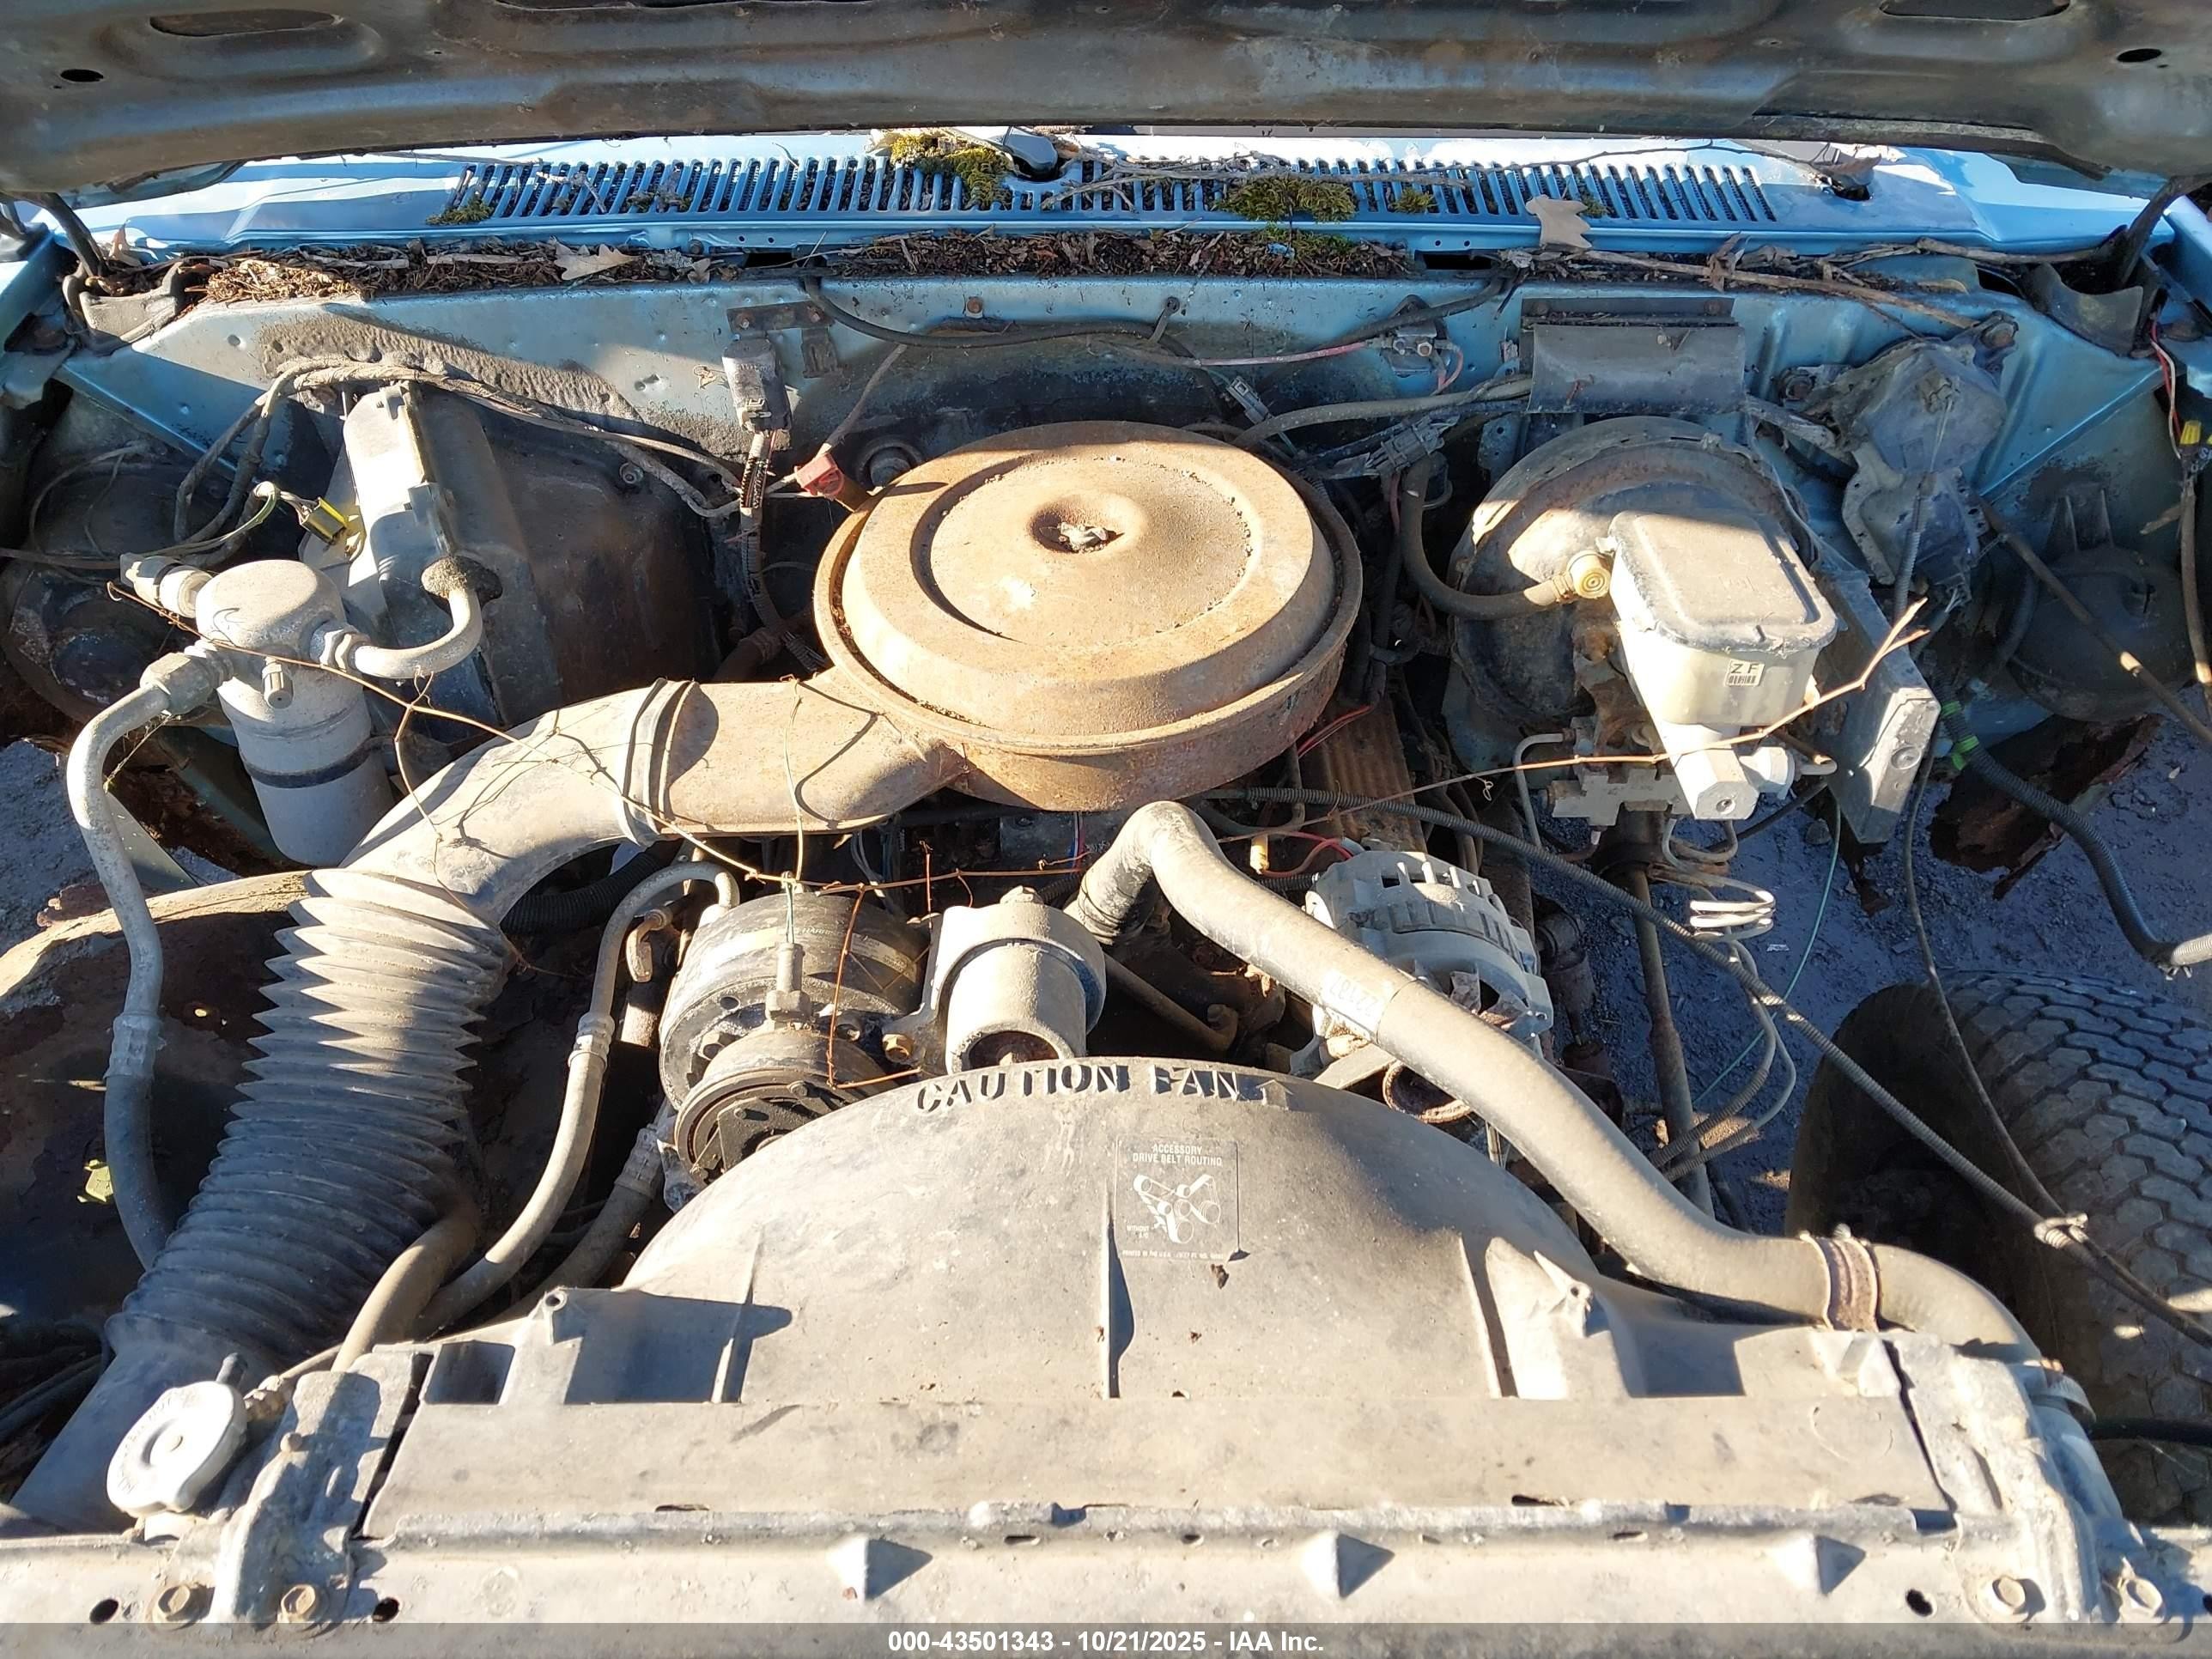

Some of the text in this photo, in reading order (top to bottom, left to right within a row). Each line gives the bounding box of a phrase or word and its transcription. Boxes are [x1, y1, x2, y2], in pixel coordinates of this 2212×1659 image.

[917, 1063, 1241, 1113] CAUTION FAN
[1152, 1143, 1203, 1155] ACCESSORY
[1133, 1152, 1223, 1167] DRIVE BELT ROUTING
